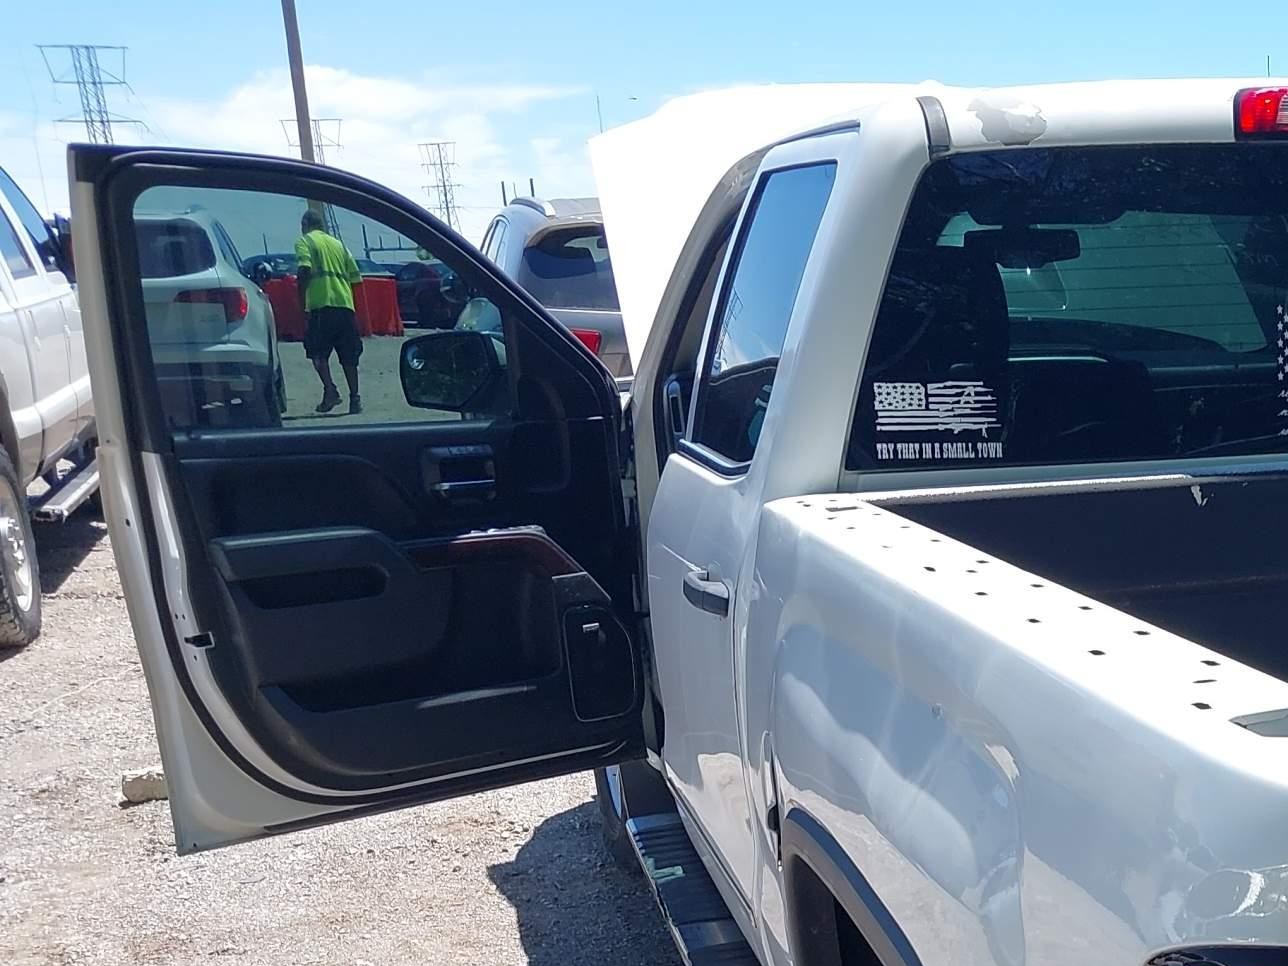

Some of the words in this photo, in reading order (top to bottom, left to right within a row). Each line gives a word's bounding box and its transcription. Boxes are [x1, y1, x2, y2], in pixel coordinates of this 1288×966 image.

[877, 443, 894, 459] TRY
[897, 443, 919, 459] THAT
[922, 443, 932, 459] IN
[935, 443, 941, 458] A
[943, 443, 975, 458] SMALL
[977, 442, 1003, 458] TOWN
